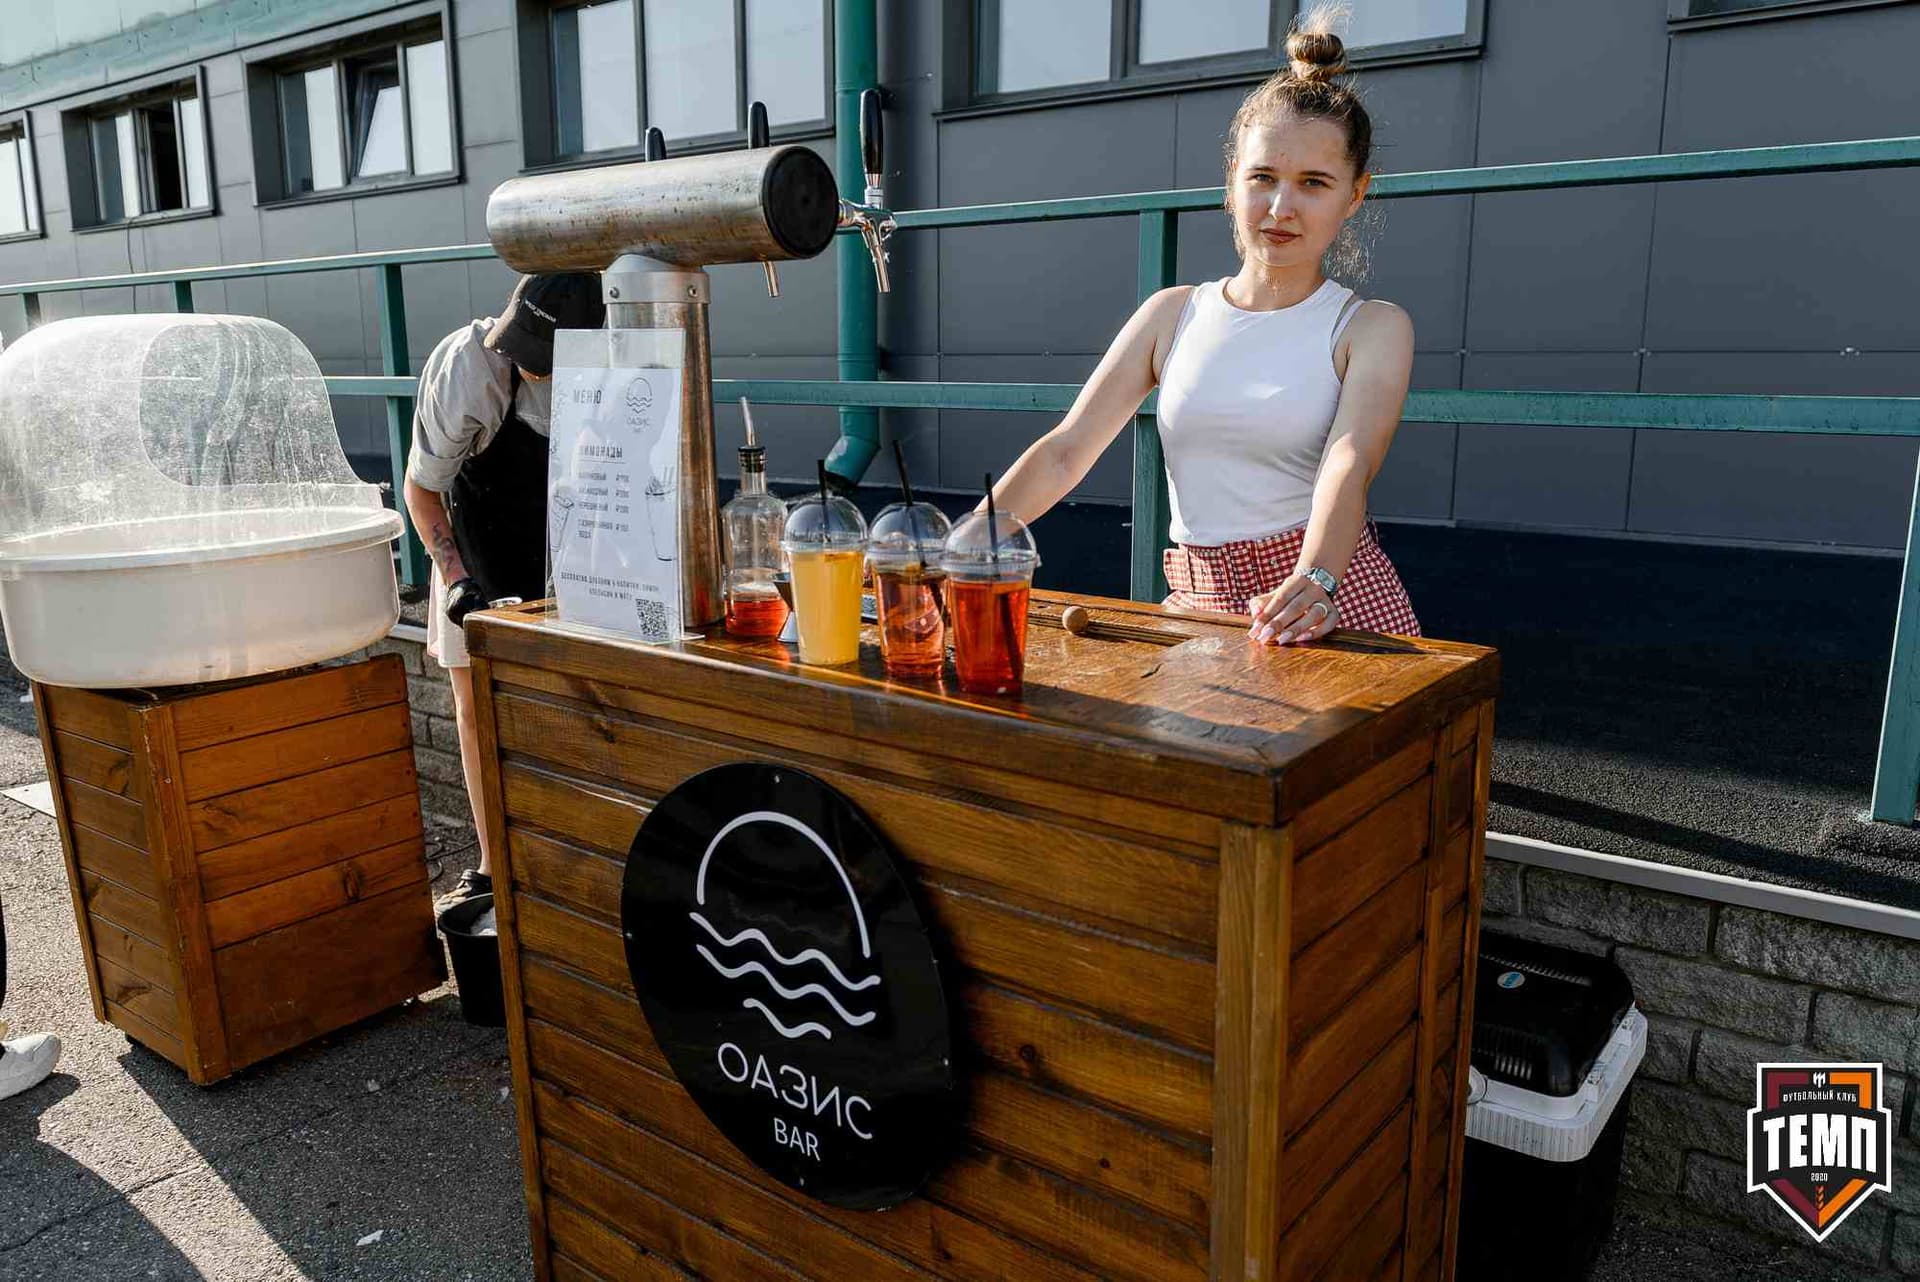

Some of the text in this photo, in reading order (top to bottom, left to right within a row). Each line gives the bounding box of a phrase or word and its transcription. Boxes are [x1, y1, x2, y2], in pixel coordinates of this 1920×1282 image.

[574, 388, 602, 405] МЕНЮ
[717, 1042, 873, 1140] ОАЗИС
[773, 1117, 821, 1162] BAR
